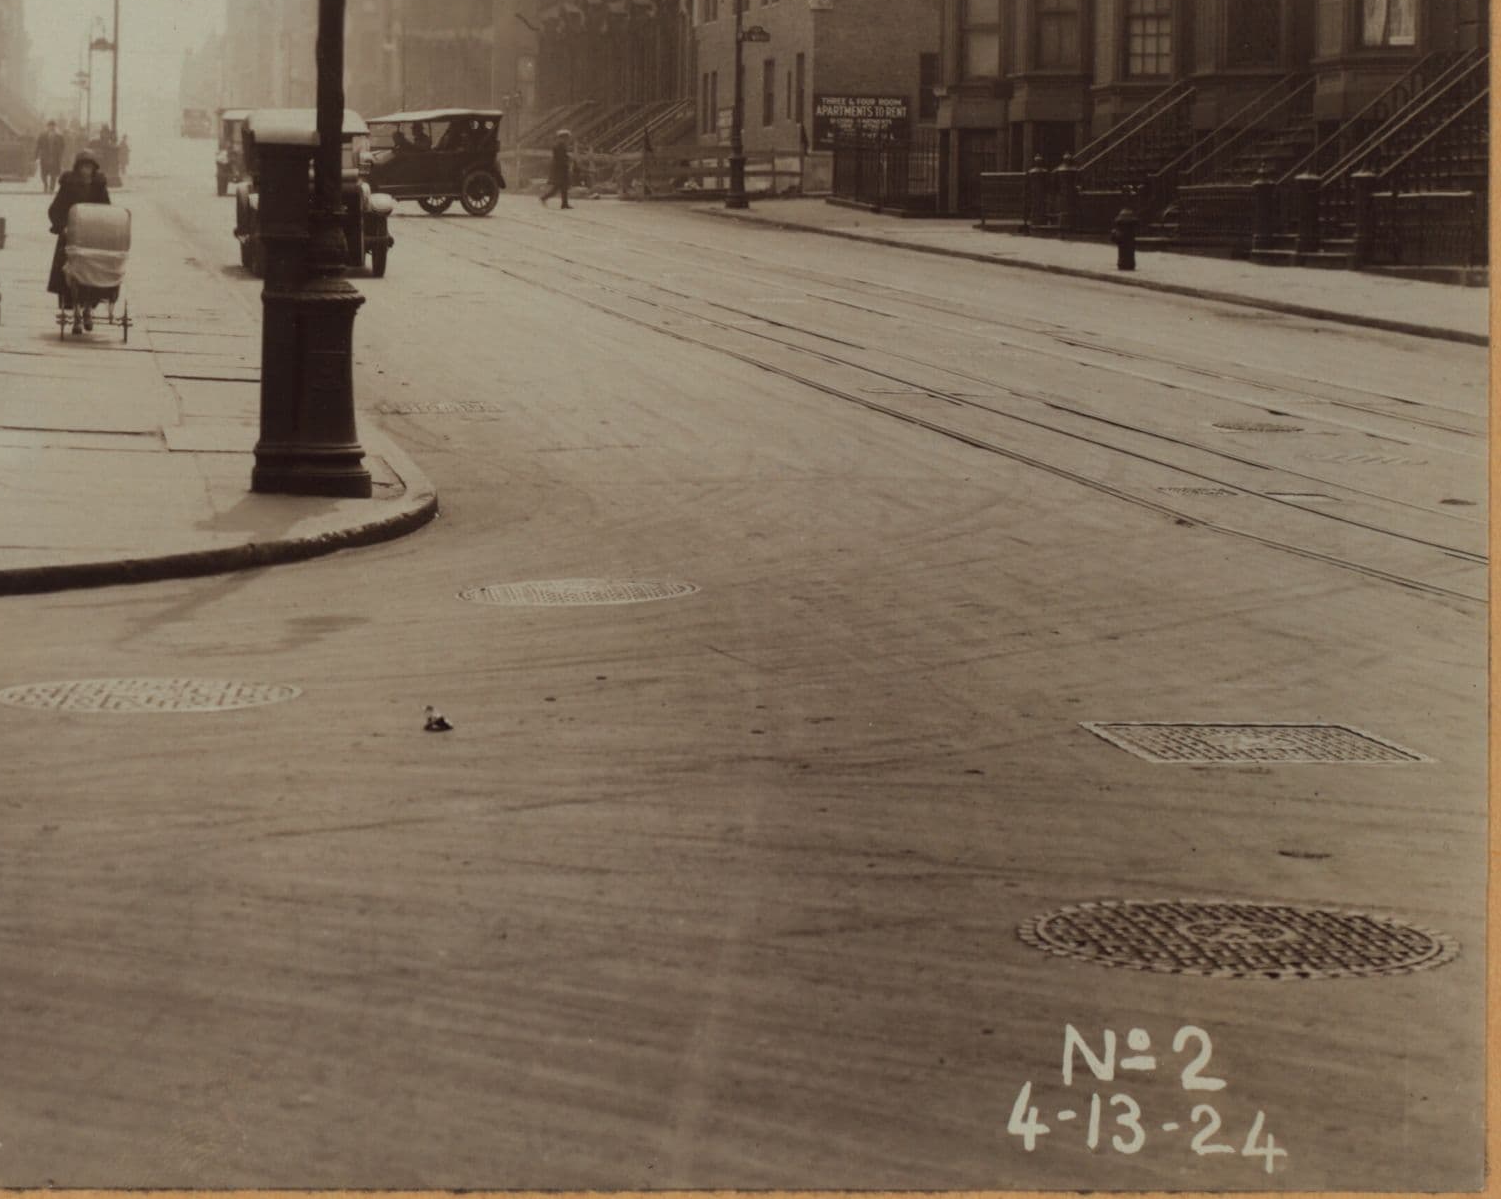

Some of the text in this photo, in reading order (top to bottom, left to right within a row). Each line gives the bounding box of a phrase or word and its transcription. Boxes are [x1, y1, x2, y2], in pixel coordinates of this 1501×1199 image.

[816, 105, 907, 118] APARTMENTS TO RENT
